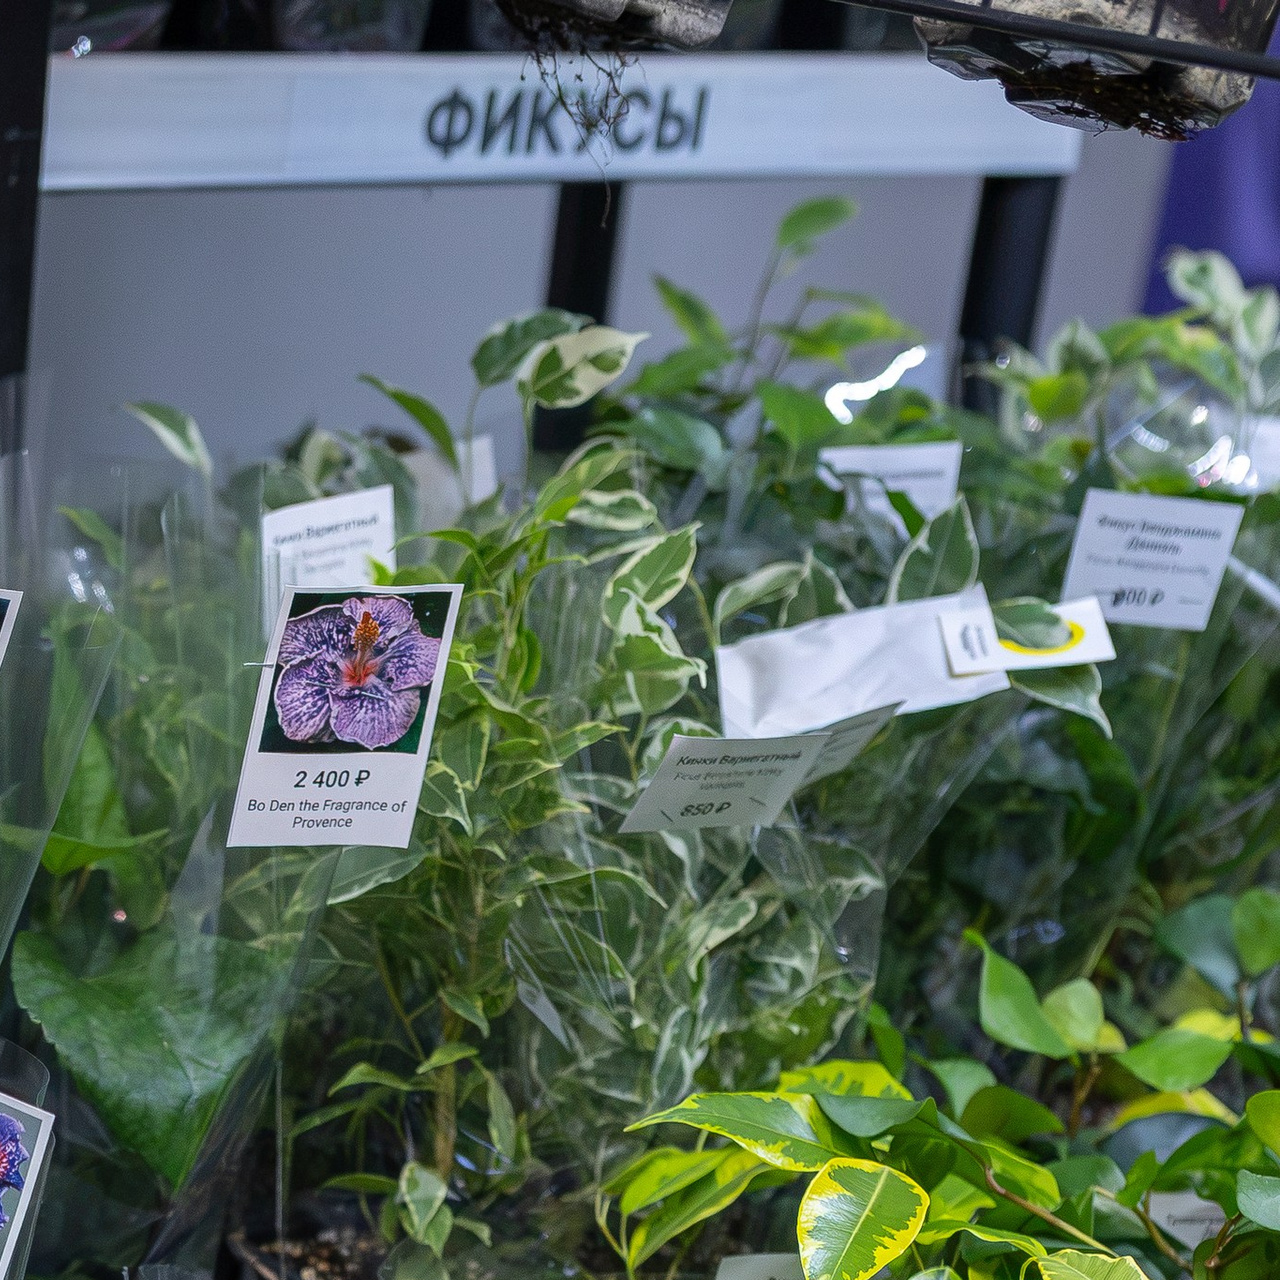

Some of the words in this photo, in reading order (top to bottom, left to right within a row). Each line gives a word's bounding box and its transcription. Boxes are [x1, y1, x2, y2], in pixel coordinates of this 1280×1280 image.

[427, 87, 709, 158] ФИКУСЫ
[293, 770, 308, 789] 2
[312, 769, 350, 789] 400
[354, 769, 371, 787] ₽
[247, 798, 266, 812] Bo
[269, 799, 296, 812] Den
[298, 799, 320, 812] the
[322, 799, 388, 814] Fragrance
[391, 800, 408, 813] of
[680, 801, 714, 817] 850
[292, 816, 353, 829] Provence
